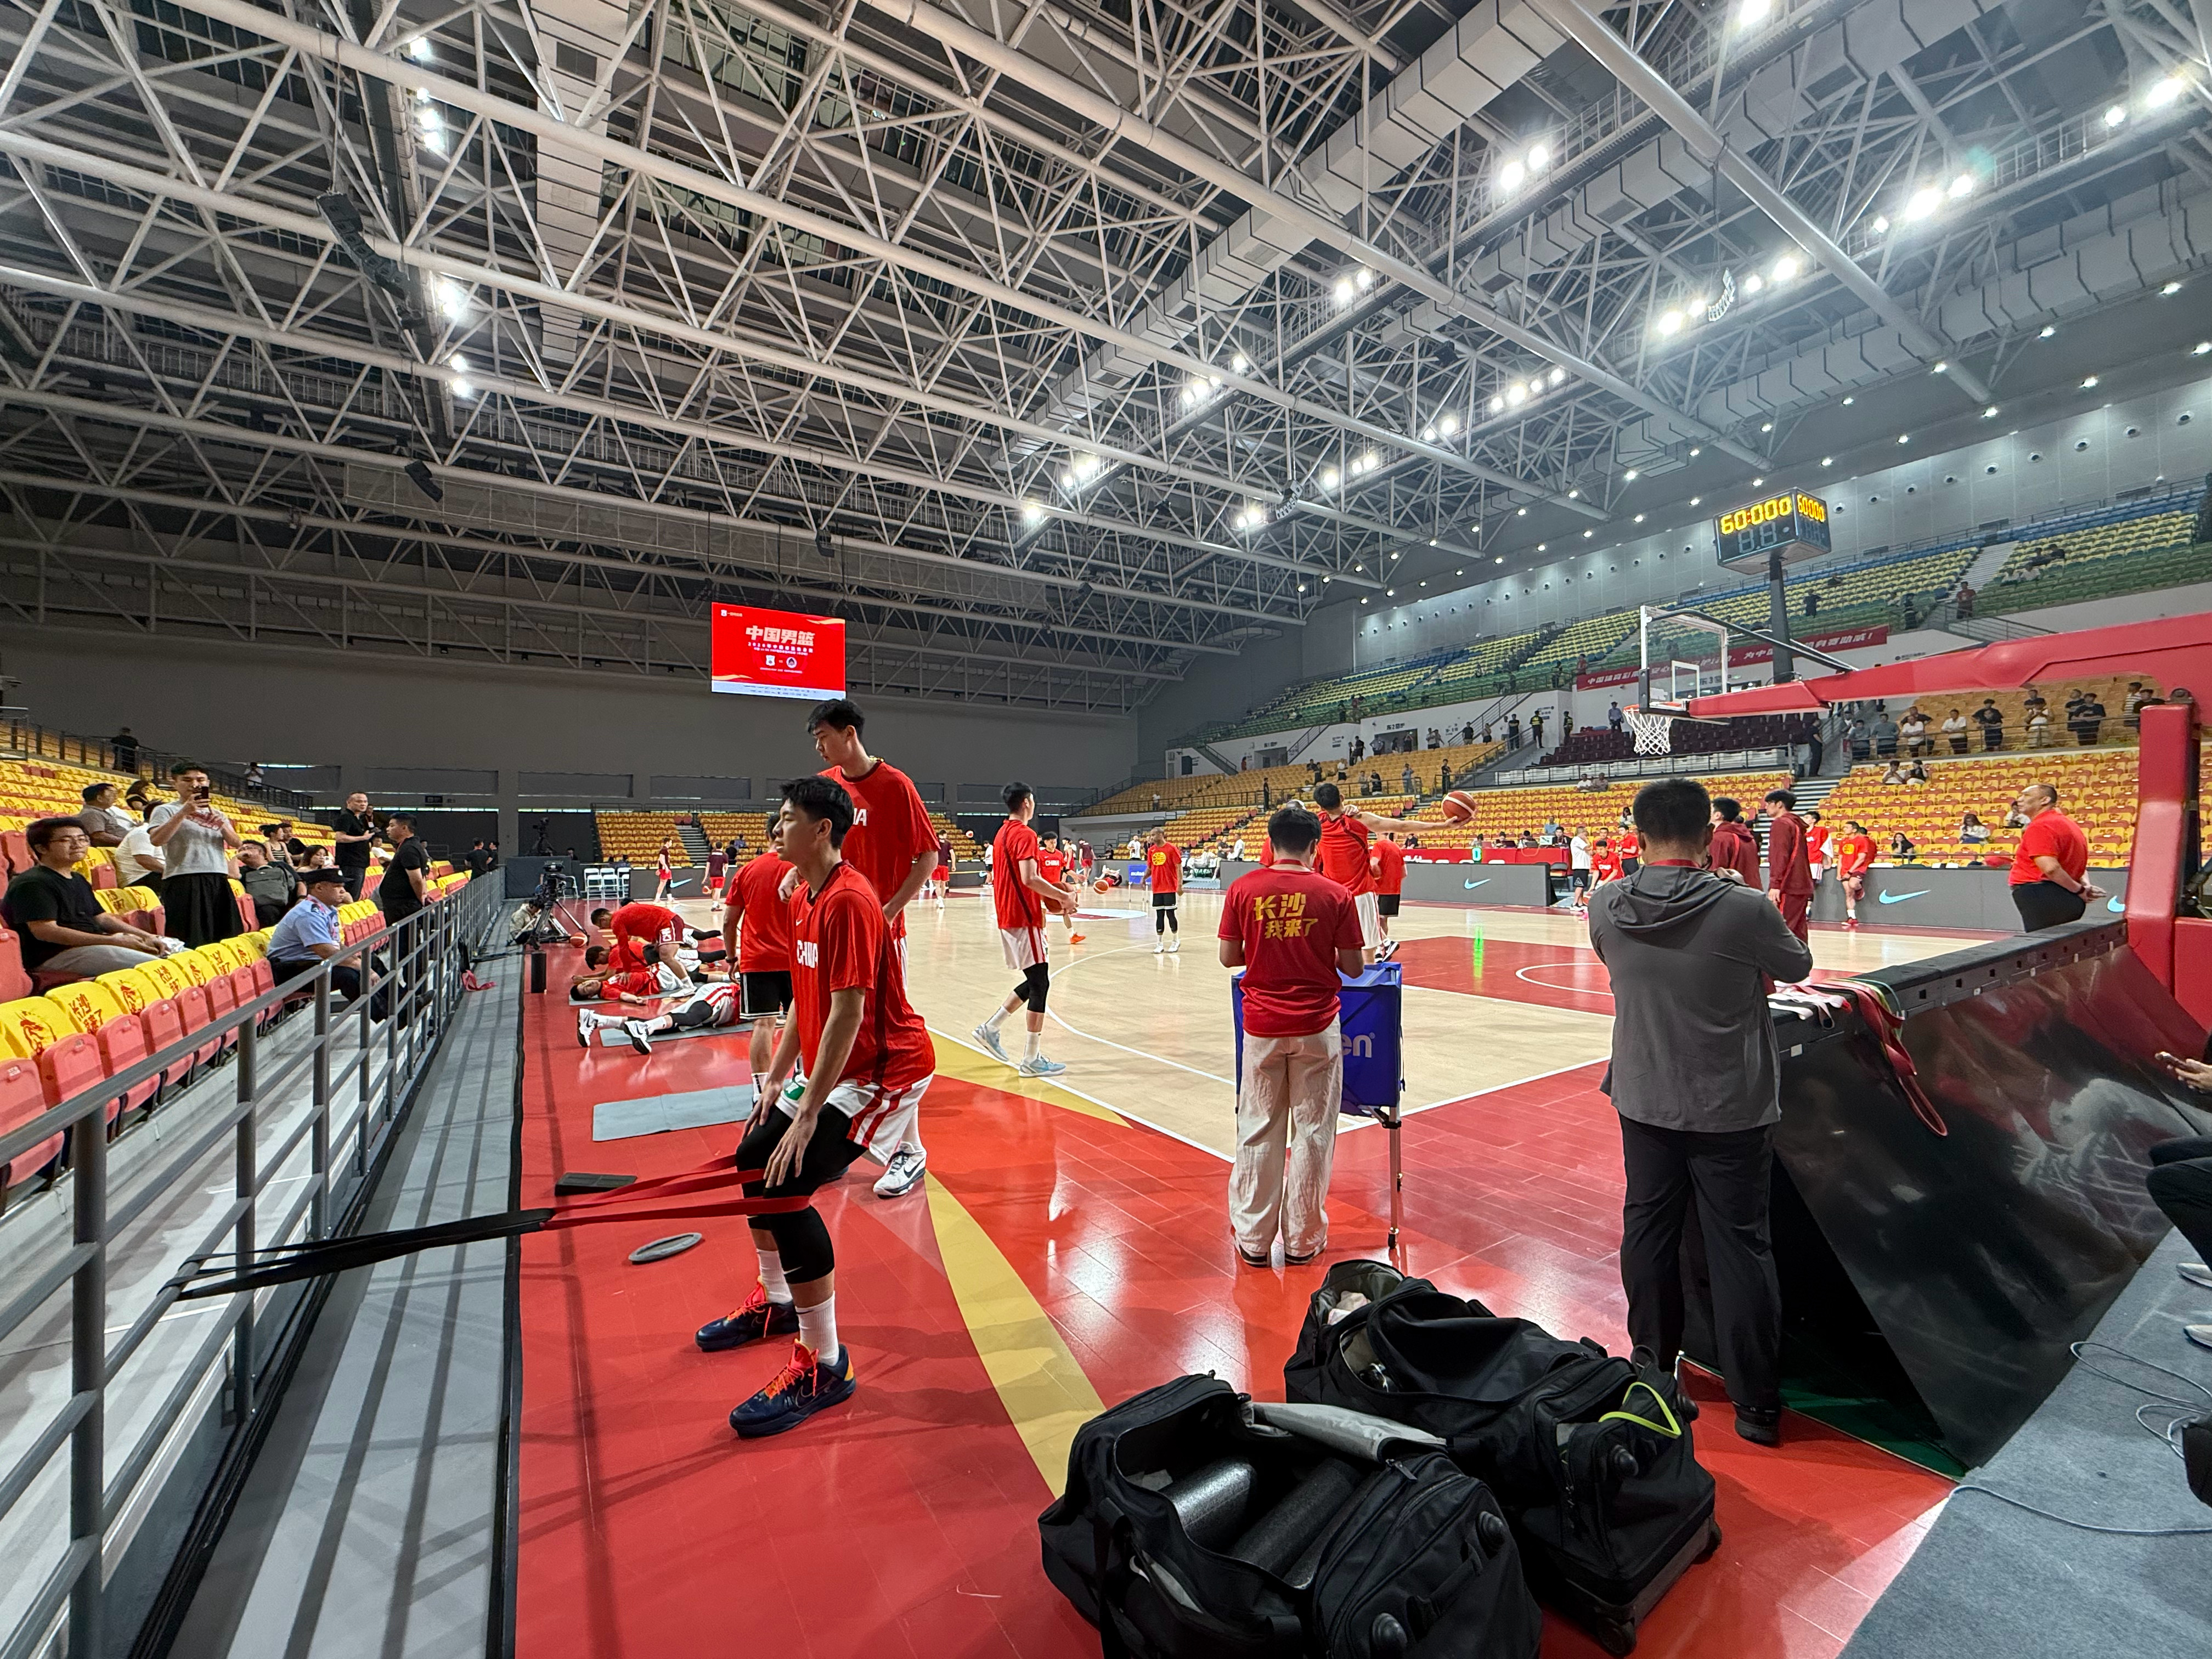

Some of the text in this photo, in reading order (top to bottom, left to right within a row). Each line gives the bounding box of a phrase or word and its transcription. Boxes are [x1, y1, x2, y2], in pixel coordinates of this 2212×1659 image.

[746, 625, 815, 646] 中国男篮
[1253, 892, 1306, 922] 长沙
[1264, 918, 1319, 941] 我来了
